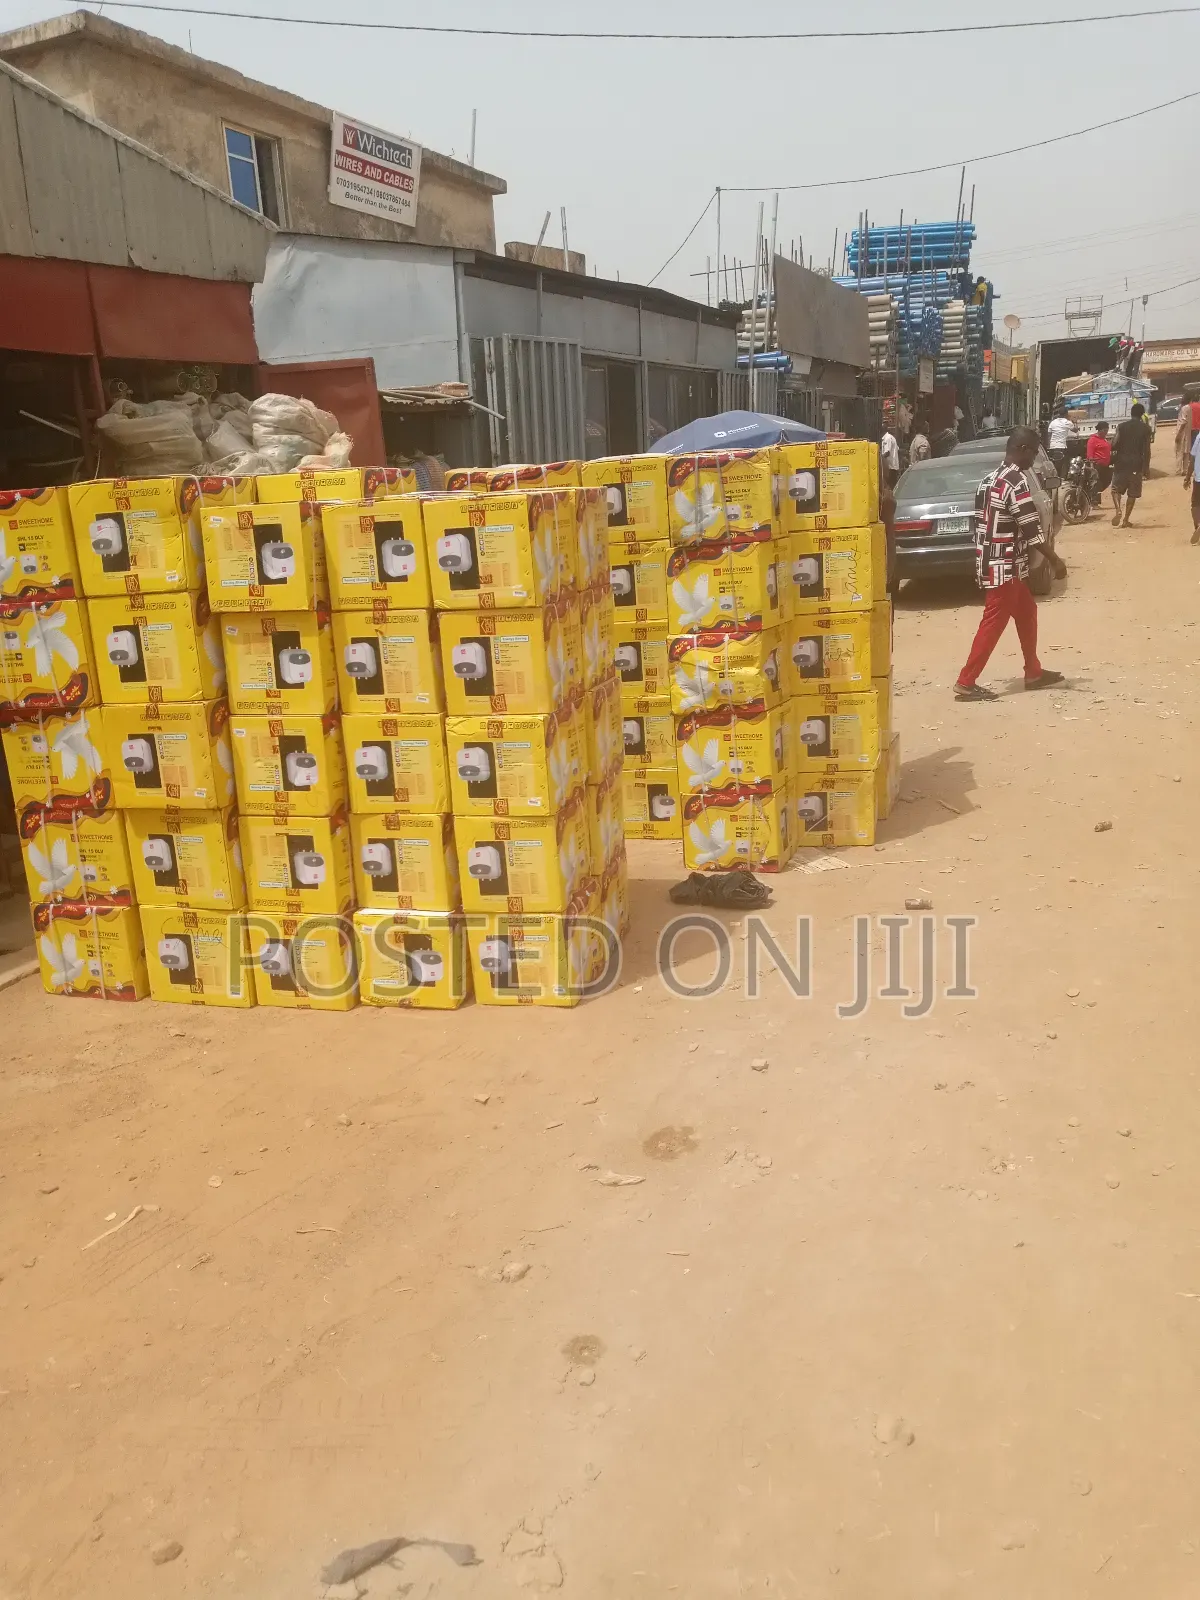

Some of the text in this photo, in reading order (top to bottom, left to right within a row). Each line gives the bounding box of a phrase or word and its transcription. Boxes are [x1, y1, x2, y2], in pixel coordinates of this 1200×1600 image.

[357, 130, 412, 169] Wichtech
[335, 154, 414, 191] WIRES AND CABLES
[345, 191, 364, 203] Better
[364, 198, 378, 207] than
[378, 203, 388, 211] the
[19, 517, 54, 525] SWEETHOME
